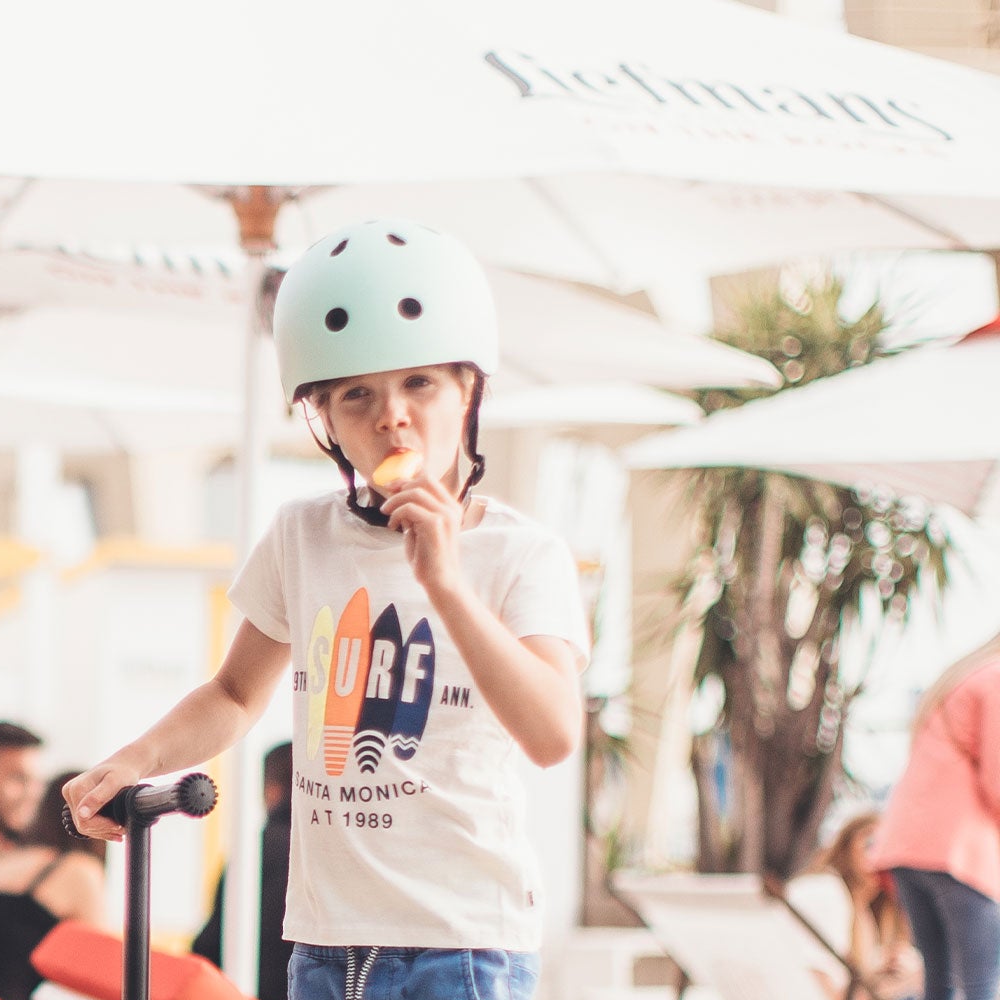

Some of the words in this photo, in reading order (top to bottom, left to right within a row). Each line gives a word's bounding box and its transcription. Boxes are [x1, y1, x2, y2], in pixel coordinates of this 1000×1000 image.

[309, 635, 432, 704] SURF
[439, 685, 475, 709] ANN.
[295, 771, 331, 802] SANTA
[343, 812, 393, 829] 1989
